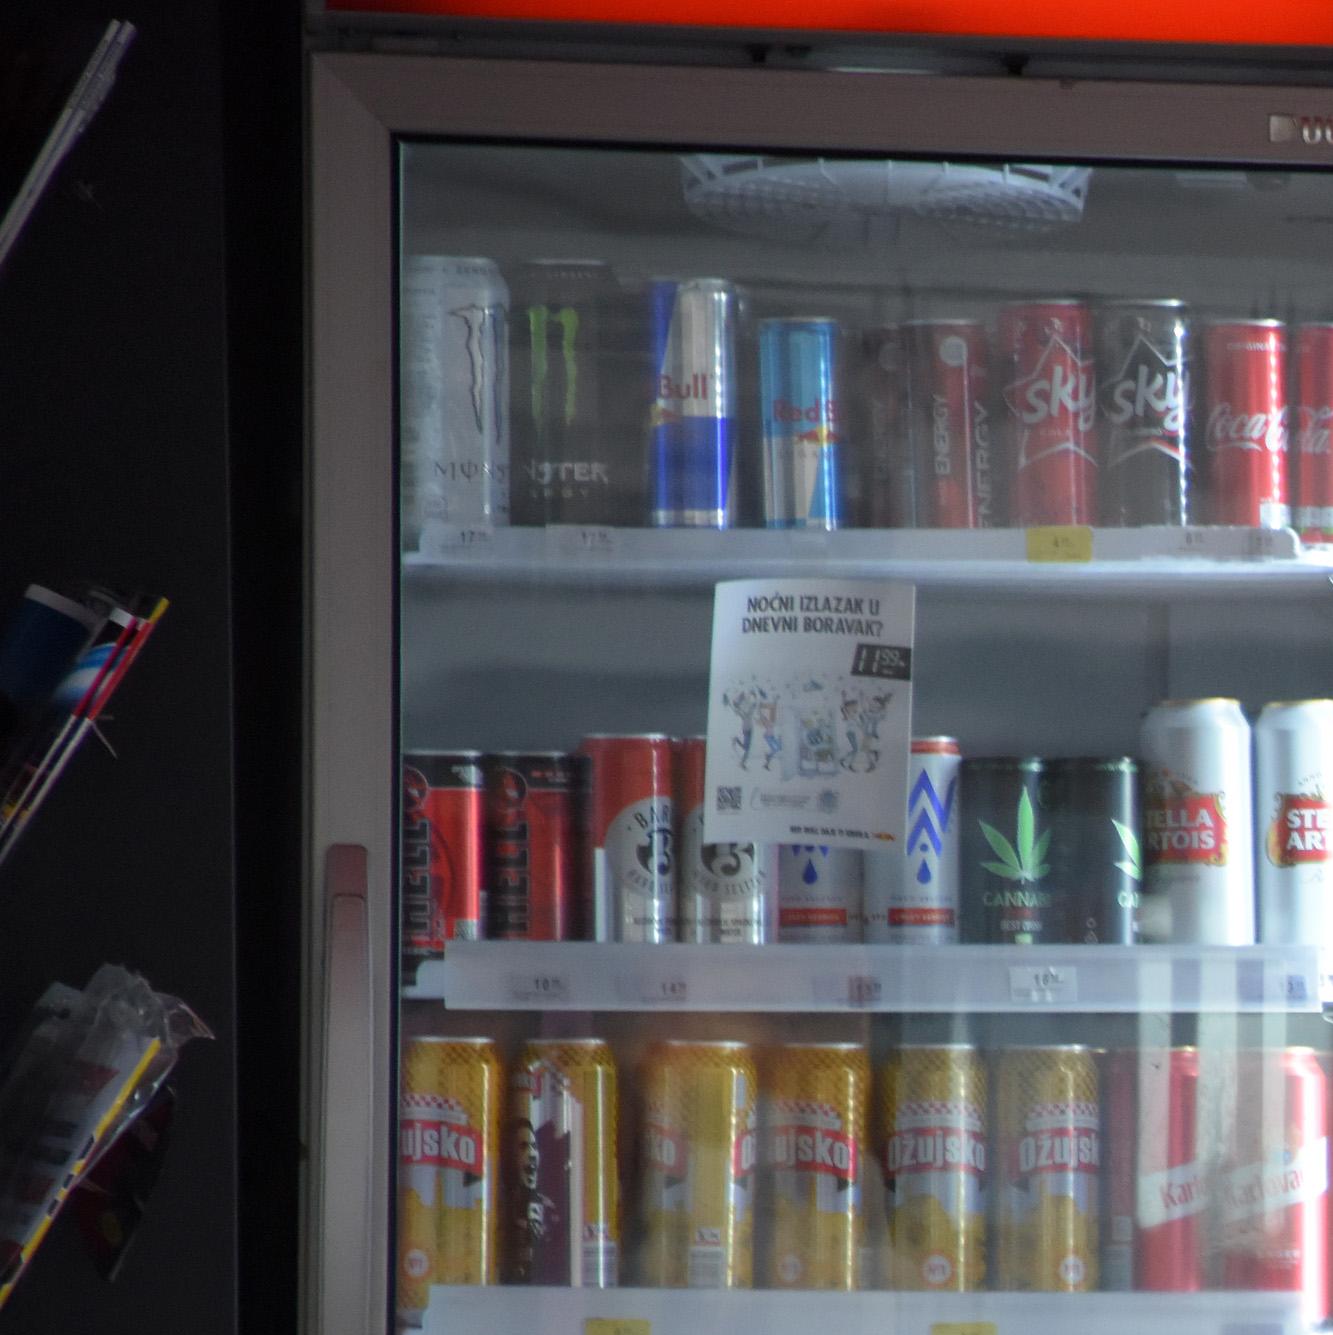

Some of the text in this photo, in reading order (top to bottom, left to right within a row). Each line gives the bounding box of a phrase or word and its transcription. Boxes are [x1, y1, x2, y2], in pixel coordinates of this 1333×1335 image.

[773, 400, 820, 424] Red
[1022, 365, 1095, 432] sky
[800, 596, 864, 615] IZLAZAK
[869, 598, 880, 615] U
[741, 617, 884, 638] DNEVNI BORAVAK?
[402, 1123, 477, 1166] ujsko
[773, 1130, 850, 1171] ujsko
[888, 1129, 987, 1173] Ožujsko
